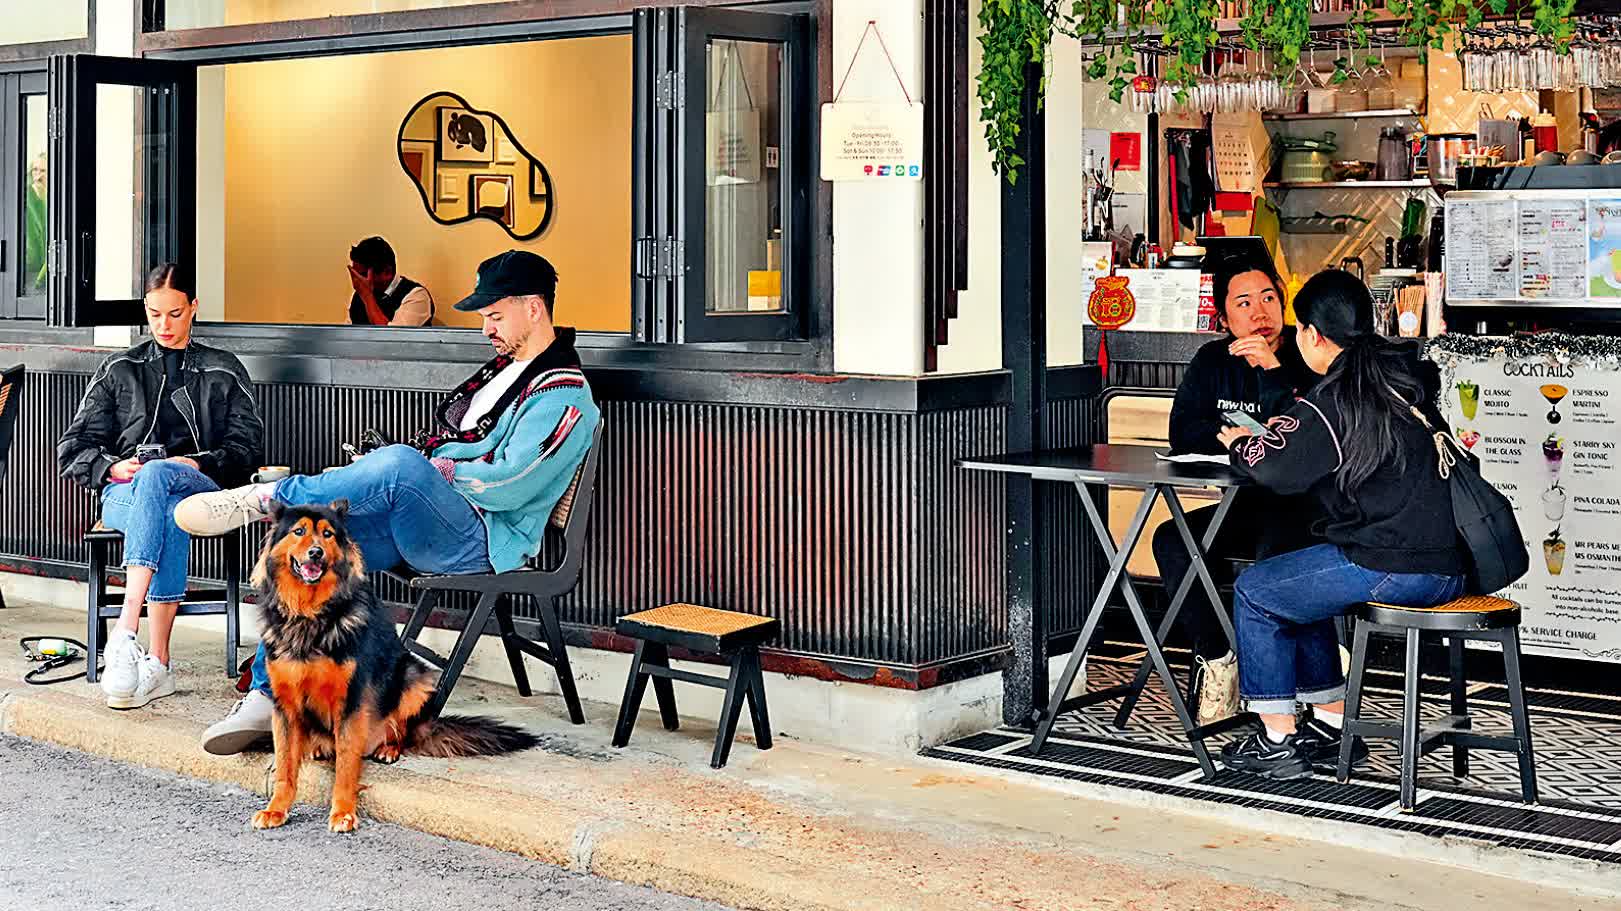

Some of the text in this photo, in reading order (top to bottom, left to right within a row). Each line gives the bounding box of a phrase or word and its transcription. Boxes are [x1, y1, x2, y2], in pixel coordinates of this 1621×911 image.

[1503, 363, 1575, 378] COCKTAILS
[1484, 389, 1512, 397] CLASSIC
[1572, 389, 1609, 397] ESPRESSO
[1484, 437, 1519, 445] BLOSSOM
[1573, 441, 1616, 449] STARRY SKY
[1485, 448, 1522, 456] THE GLASS
[1573, 452, 1608, 461] GIN TONIC
[1592, 497, 1620, 505] COLADA
[1575, 541, 1586, 549] MR
[1586, 542, 1611, 550] PEARS
[1575, 552, 1585, 560] MS
[1559, 594, 1583, 602] cocktails
[1567, 605, 1604, 614] non-alcoholic
[1530, 627, 1562, 637] SERVICE
[1565, 630, 1598, 640] CHARGE
